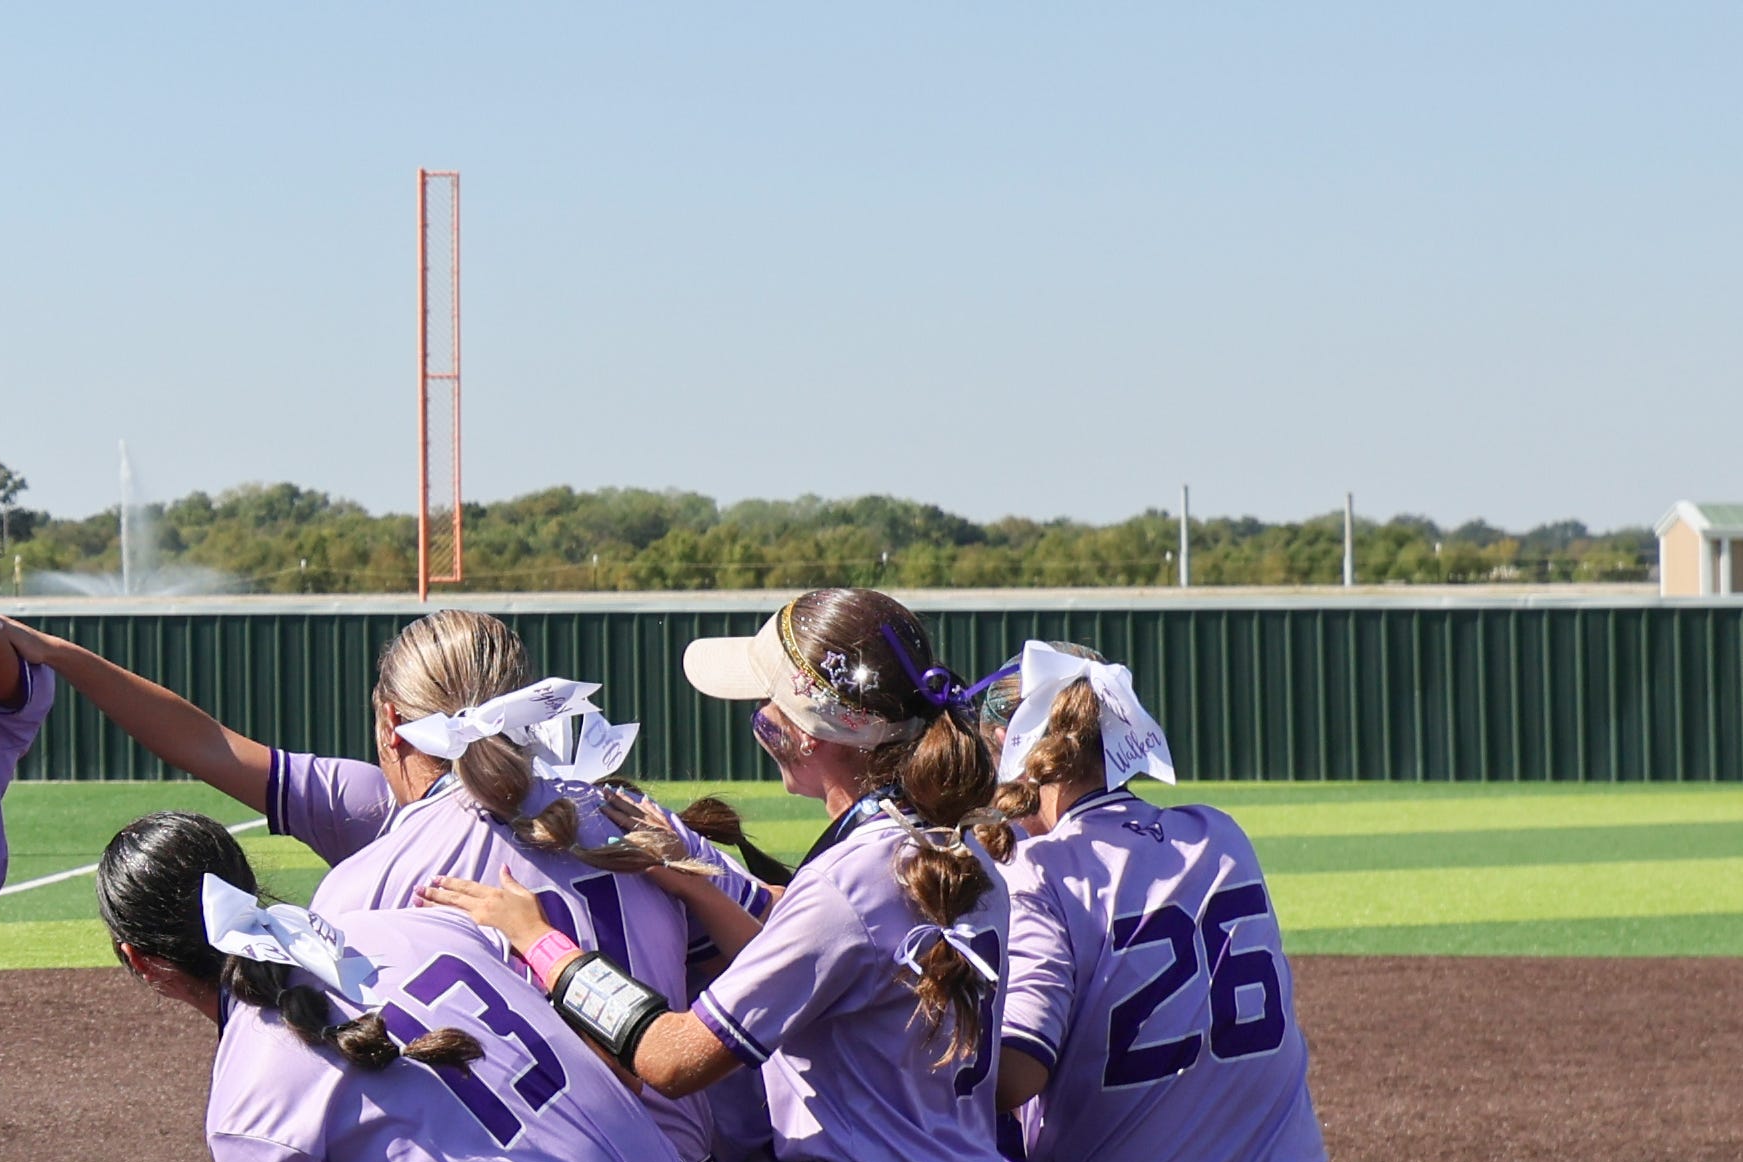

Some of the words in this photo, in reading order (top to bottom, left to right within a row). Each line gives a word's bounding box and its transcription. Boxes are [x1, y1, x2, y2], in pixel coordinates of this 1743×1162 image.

[1105, 729, 1162, 774] Walker
[378, 952, 571, 1151] 13
[1102, 878, 1286, 1091] 26
